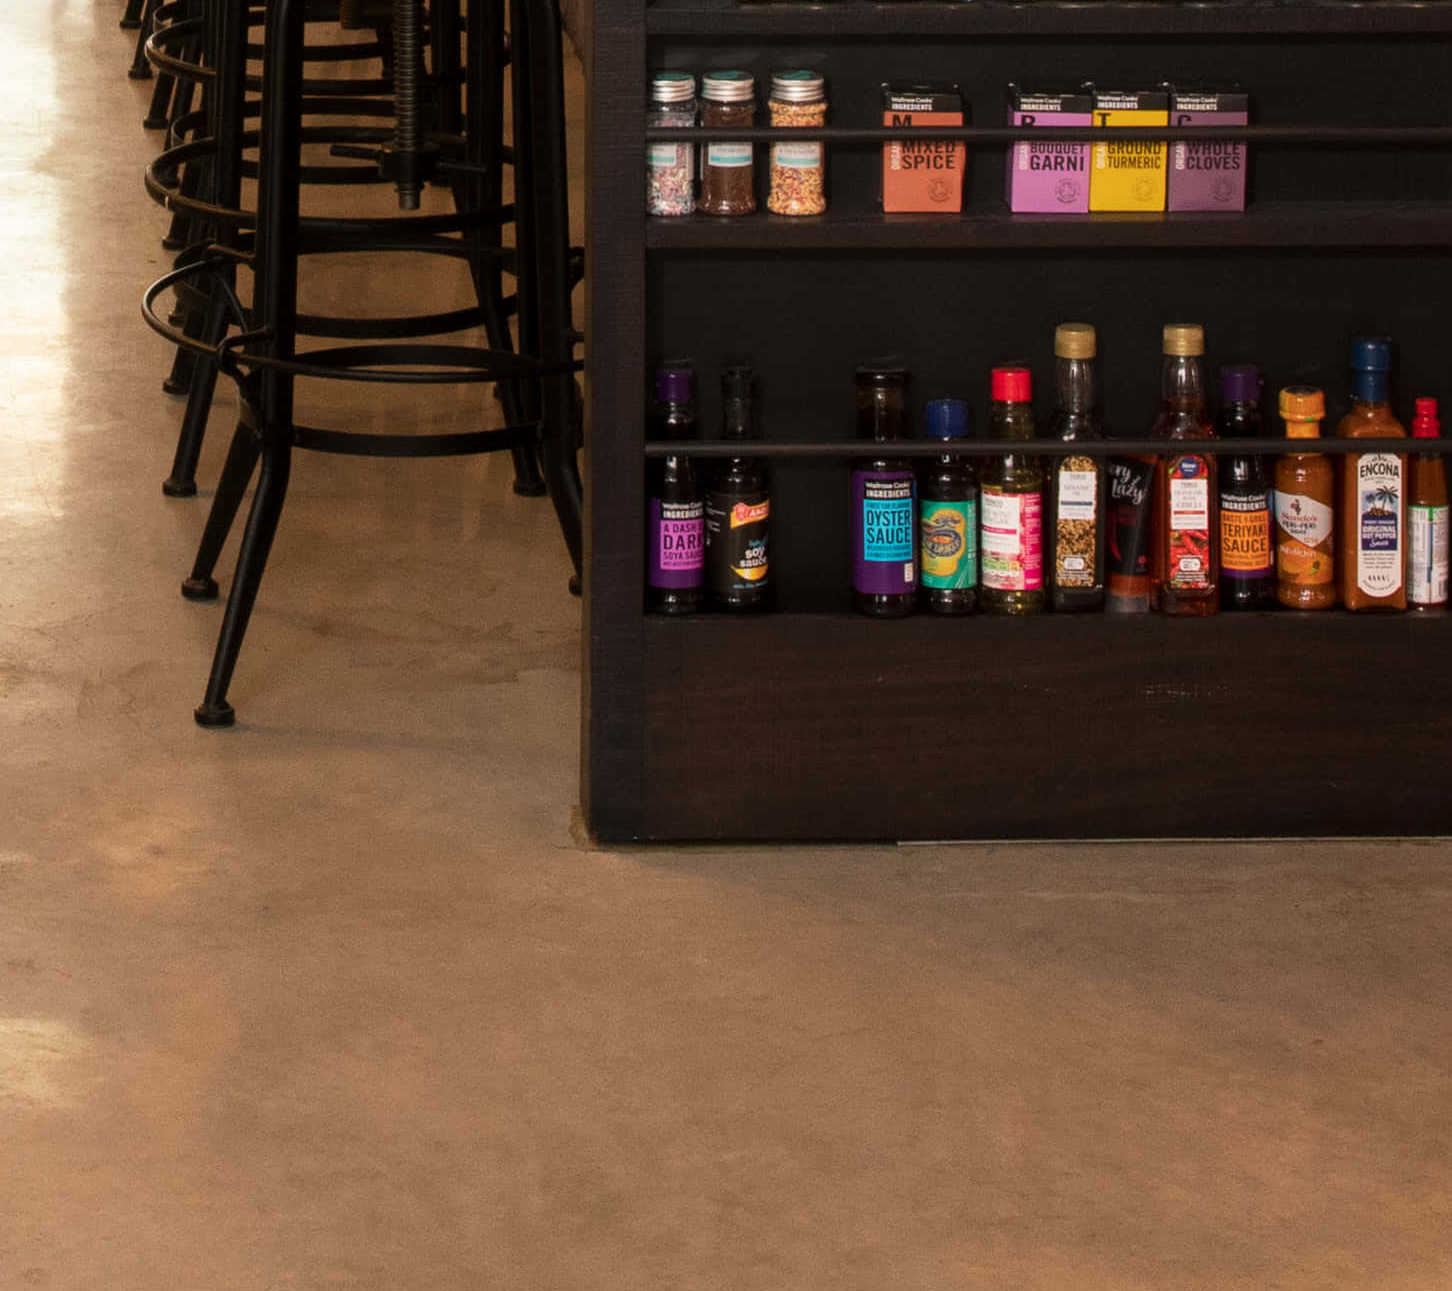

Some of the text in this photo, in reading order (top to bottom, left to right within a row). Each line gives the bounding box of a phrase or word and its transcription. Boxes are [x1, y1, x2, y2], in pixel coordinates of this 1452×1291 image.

[892, 103, 933, 111] INGREDIENTS
[902, 140, 956, 154] MIXED
[1031, 142, 1084, 155] BOUQUET
[1108, 141, 1161, 155] GROUND
[1186, 141, 1240, 155] WHOLE
[902, 155, 956, 170] SPICE
[1031, 156, 1084, 171] GARNI
[1108, 156, 1161, 169] TURMERIC
[1187, 156, 1240, 170] CLOVES
[1360, 463, 1400, 478] ENCONA
[662, 508, 703, 518] INGREDIEN
[866, 509, 911, 526] OYSTER
[1281, 511, 1317, 521] Nando's
[663, 523, 669, 533] A
[1223, 522, 1266, 537] TERIYAKI
[1282, 520, 1317, 529] PERI-PERI
[866, 526, 910, 545] SAUCE
[745, 546, 765, 558] soy
[1223, 538, 1266, 553] SAUCE
